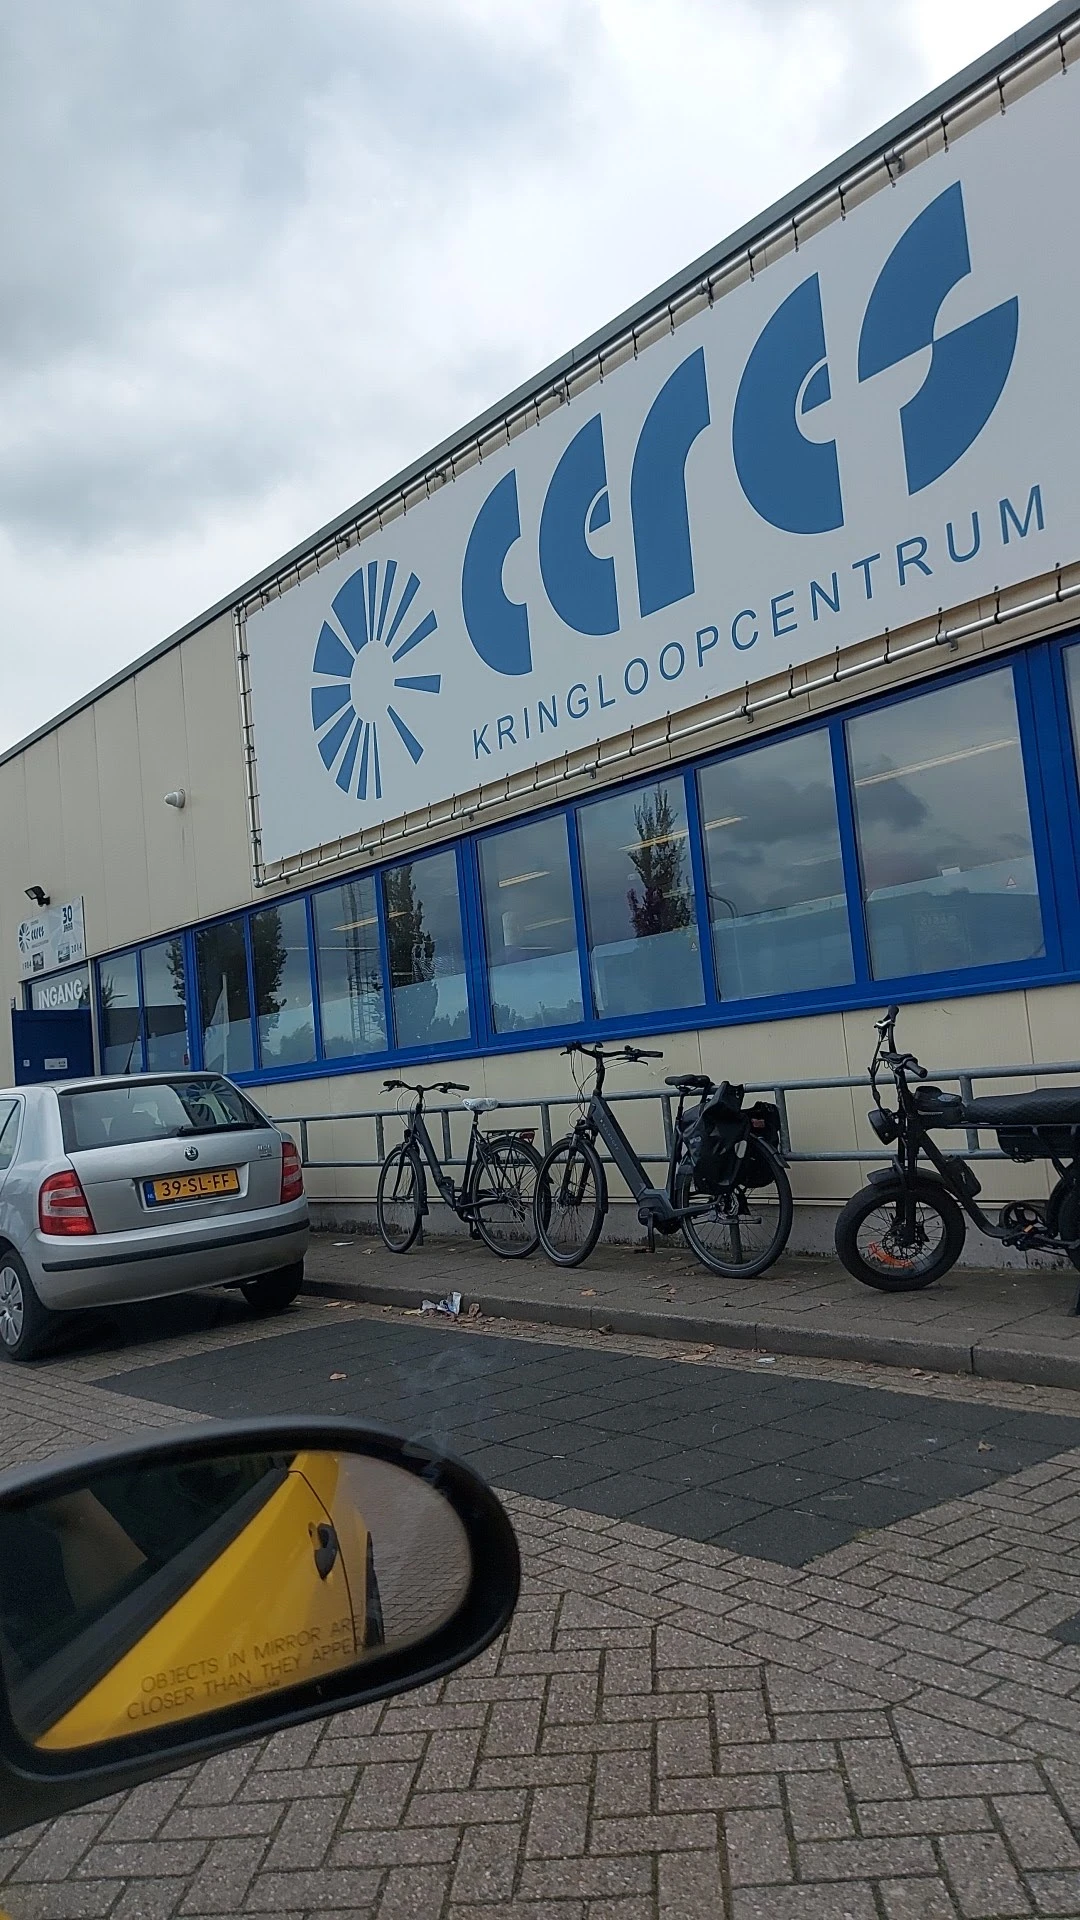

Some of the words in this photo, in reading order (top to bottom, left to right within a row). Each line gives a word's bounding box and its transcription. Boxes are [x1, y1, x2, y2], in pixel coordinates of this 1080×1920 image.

[472, 485, 1045, 759] KRINGLOOPCENTRUM
[62, 905, 73, 924] 30
[38, 979, 83, 1009] INGANG
[161, 1173, 229, 1197] 39-SL-FF
[127, 1686, 195, 1721] CLOSER
[203, 1670, 251, 1696] THAN
[261, 1654, 301, 1680] THEY
[312, 1636, 366, 1664] APPEA
[141, 1658, 219, 1694] OBJECTS
[228, 1650, 246, 1668] IN
[254, 1626, 322, 1660] MIRROR
[330, 1614, 362, 1638] ARE
